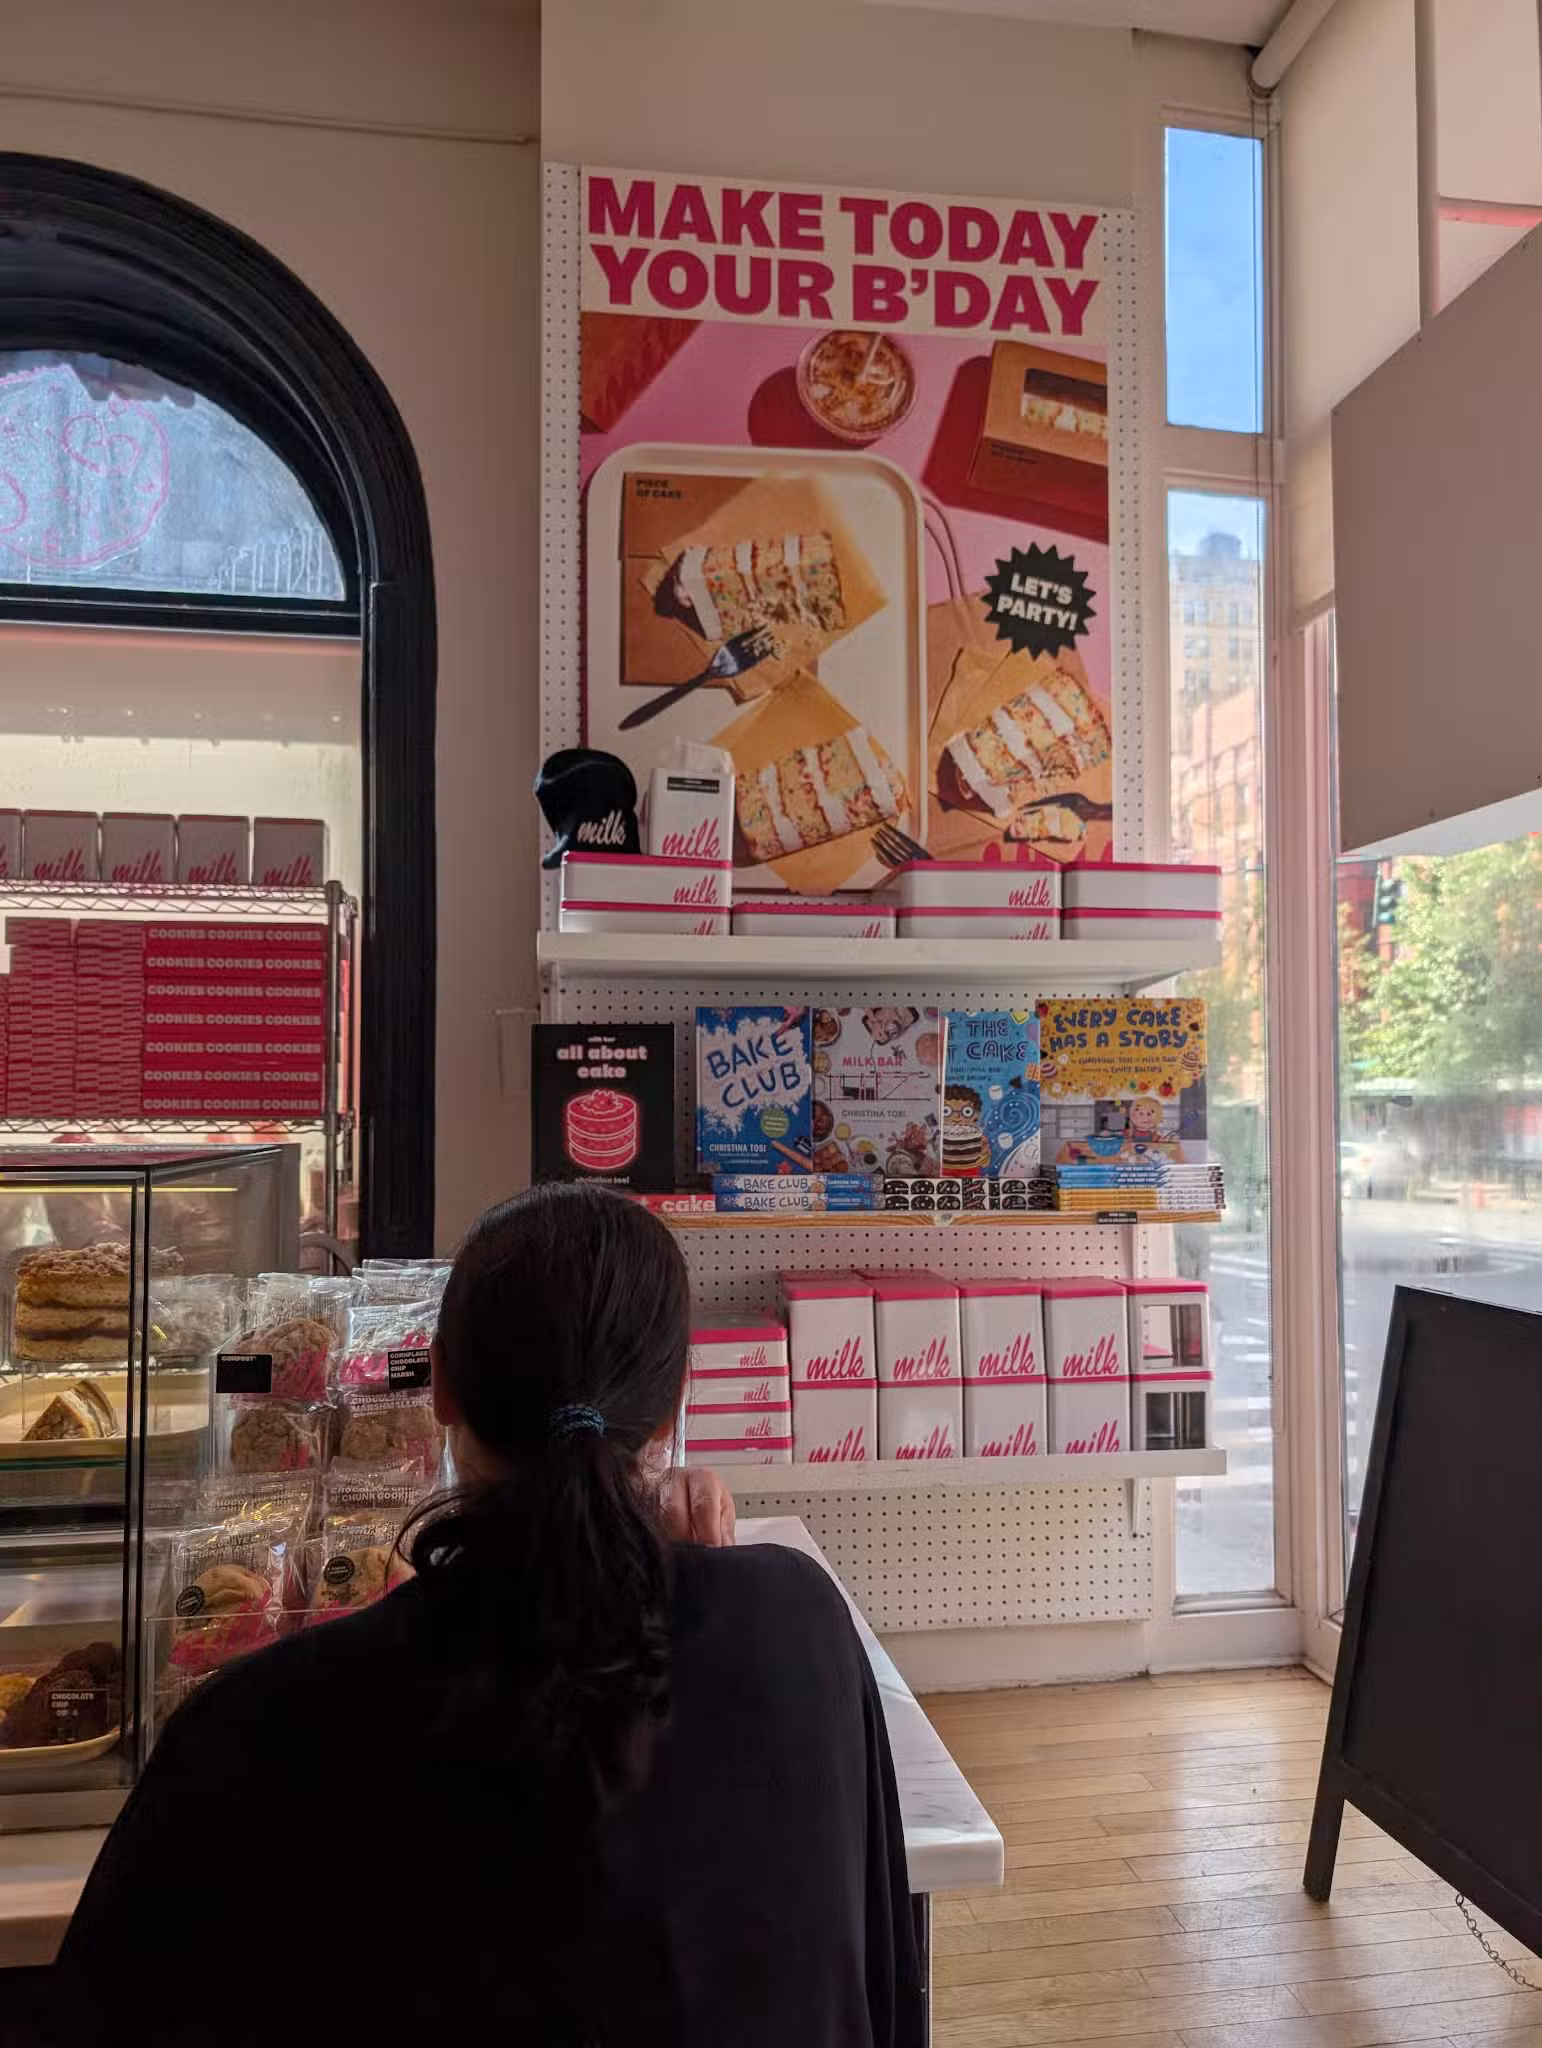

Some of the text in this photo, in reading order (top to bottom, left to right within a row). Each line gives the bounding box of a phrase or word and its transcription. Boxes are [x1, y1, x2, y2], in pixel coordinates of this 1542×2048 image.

[588, 176, 1099, 270] MAKE TODAY
[590, 244, 1100, 336] YOUR B'DAY
[1011, 572, 1073, 606] LET'S
[996, 593, 1079, 632] PARTY!
[577, 809, 627, 846] milk
[662, 817, 720, 859] milk
[34, 848, 85, 881] milk
[112, 850, 161, 883] milk
[189, 851, 238, 883] milk
[264, 853, 312, 886] milk
[674, 875, 718, 905] milk
[1008, 878, 1051, 906] milk
[149, 928, 321, 941] COOKIES COOKIES COOKIES
[147, 957, 321, 970] COOKIES COOKIES COOKIES
[147, 985, 320, 998] COOKIES COOKIES COOKIES
[146, 1014, 321, 1026] COOKIES COOKIES COOKIES
[965, 1019, 1008, 1037] THE
[1053, 1007, 1181, 1033] EVERY CAKE
[146, 1042, 320, 1054] COOKIES COOKIES COOKIES
[1096, 1032, 1109, 1047] A
[1119, 1030, 1187, 1048] STORY
[557, 1045, 648, 1060] all about
[707, 1033, 794, 1079] BAKE
[843, 1056, 903, 1067] MILK BAR
[967, 1041, 1029, 1063] CAKE
[144, 1070, 319, 1082] COOKIES COOKIES COOKIES
[577, 1064, 627, 1078] cake
[722, 1062, 801, 1107] CLUB
[143, 1098, 319, 1110] COOKIES COOKIES COOKIES
[709, 1143, 767, 1153] CHRISTINA TOSI
[743, 1178, 808, 1190] BAKE CLUB
[661, 1194, 716, 1212] cake
[744, 1196, 809, 1208] BAKE CLUB
[390, 1351, 428, 1359] CORNFLAKE
[390, 1357, 429, 1365] CHOCOLATE
[740, 1345, 767, 1366] milk
[807, 1335, 864, 1380] milk
[894, 1335, 951, 1380] milk
[979, 1332, 1036, 1376] milk
[1063, 1332, 1119, 1376] milk
[744, 1382, 769, 1402] milk
[745, 1416, 771, 1437] milk
[342, 1492, 376, 1503] CHUNK
